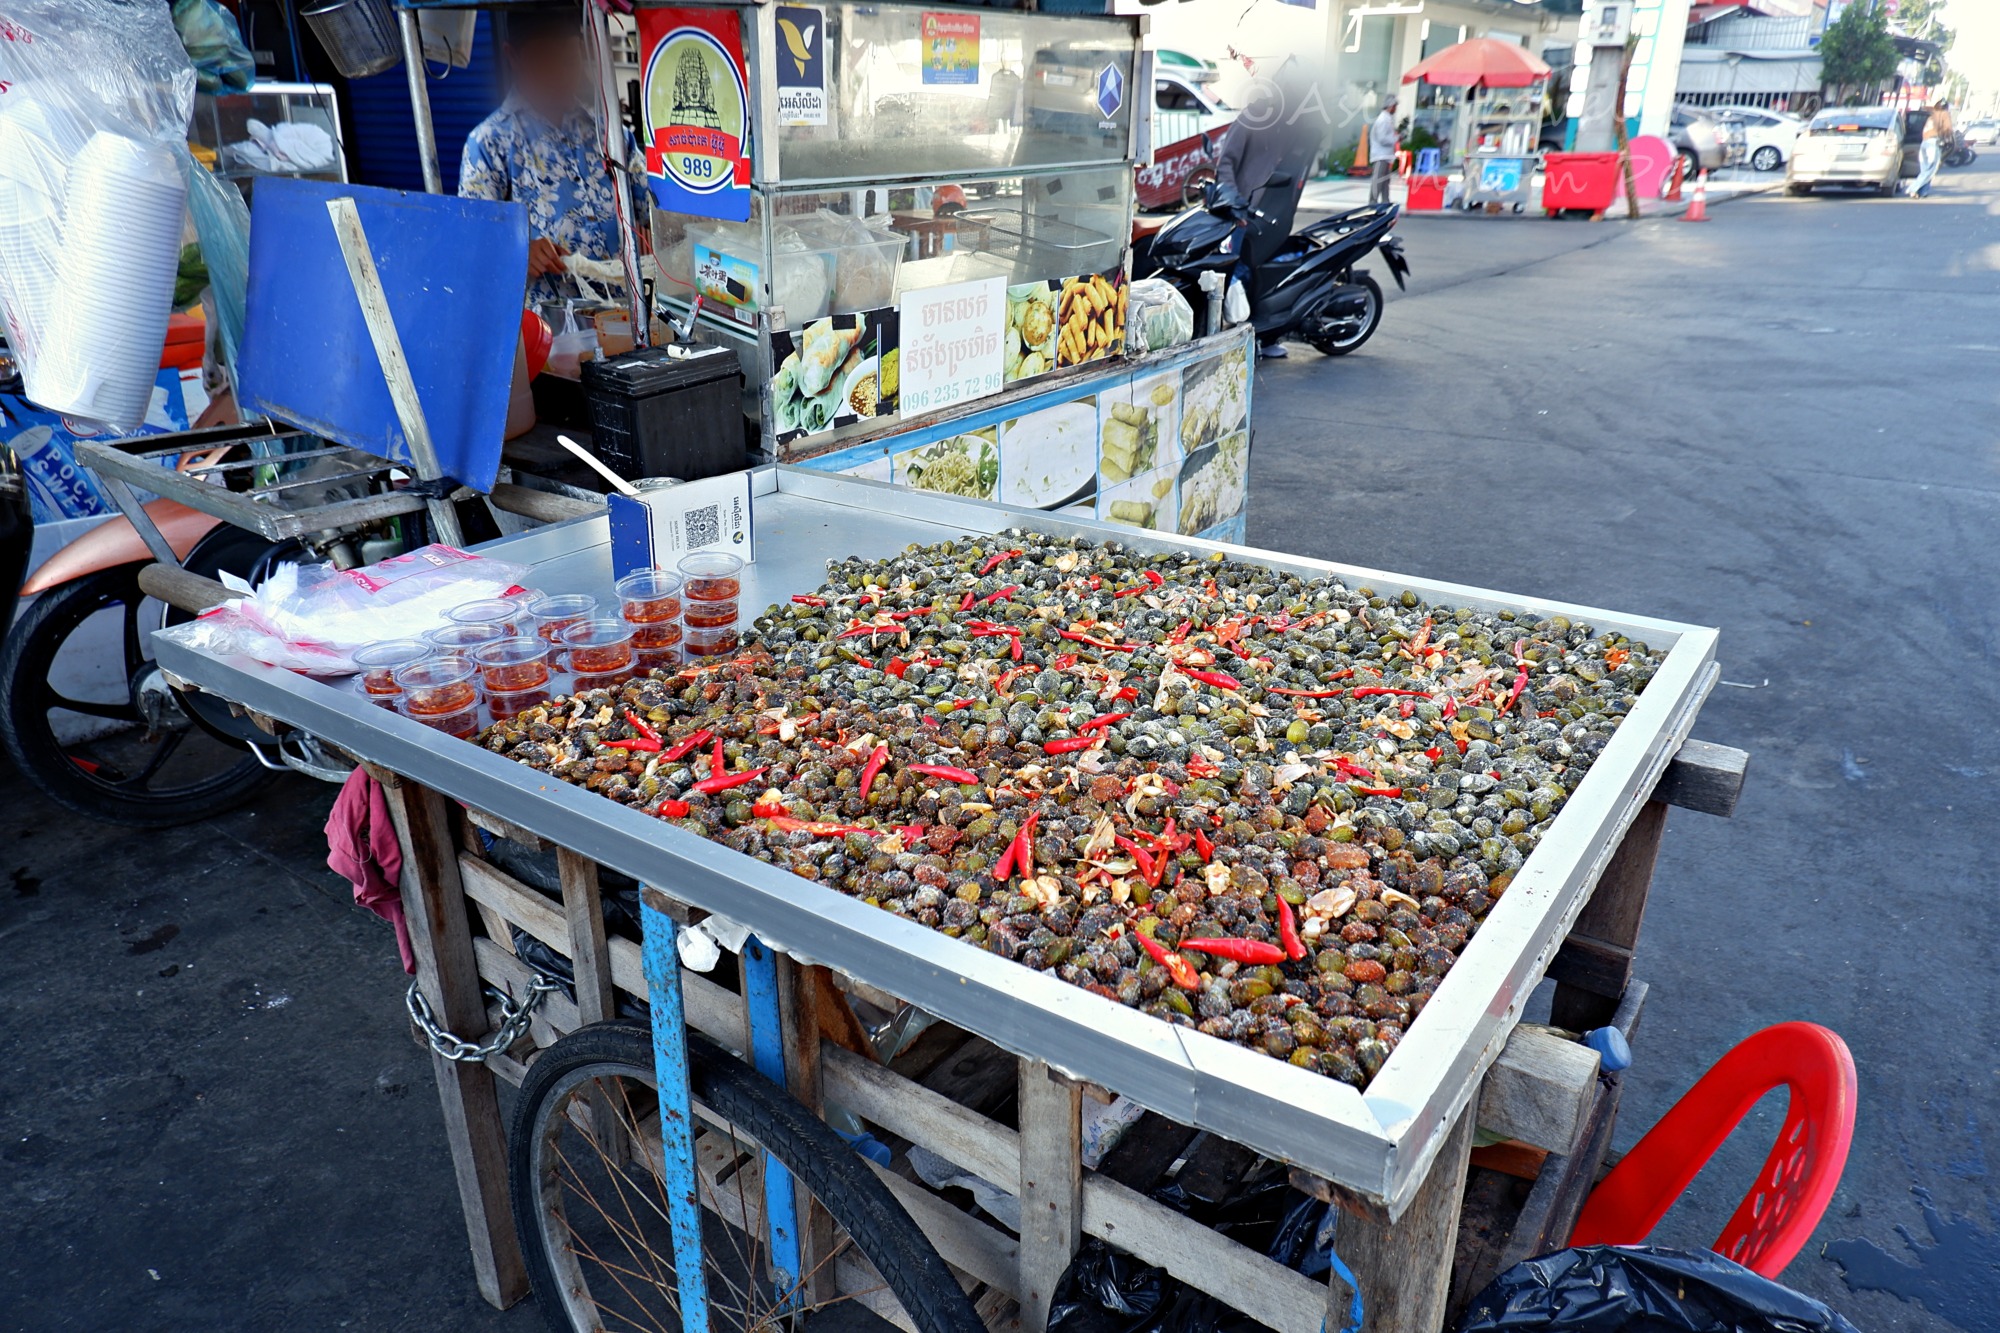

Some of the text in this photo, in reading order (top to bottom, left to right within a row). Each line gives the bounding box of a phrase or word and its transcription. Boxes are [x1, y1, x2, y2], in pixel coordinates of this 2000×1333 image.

[683, 157, 712, 178] 989
[902, 371, 1001, 412] 096 235 72 96
